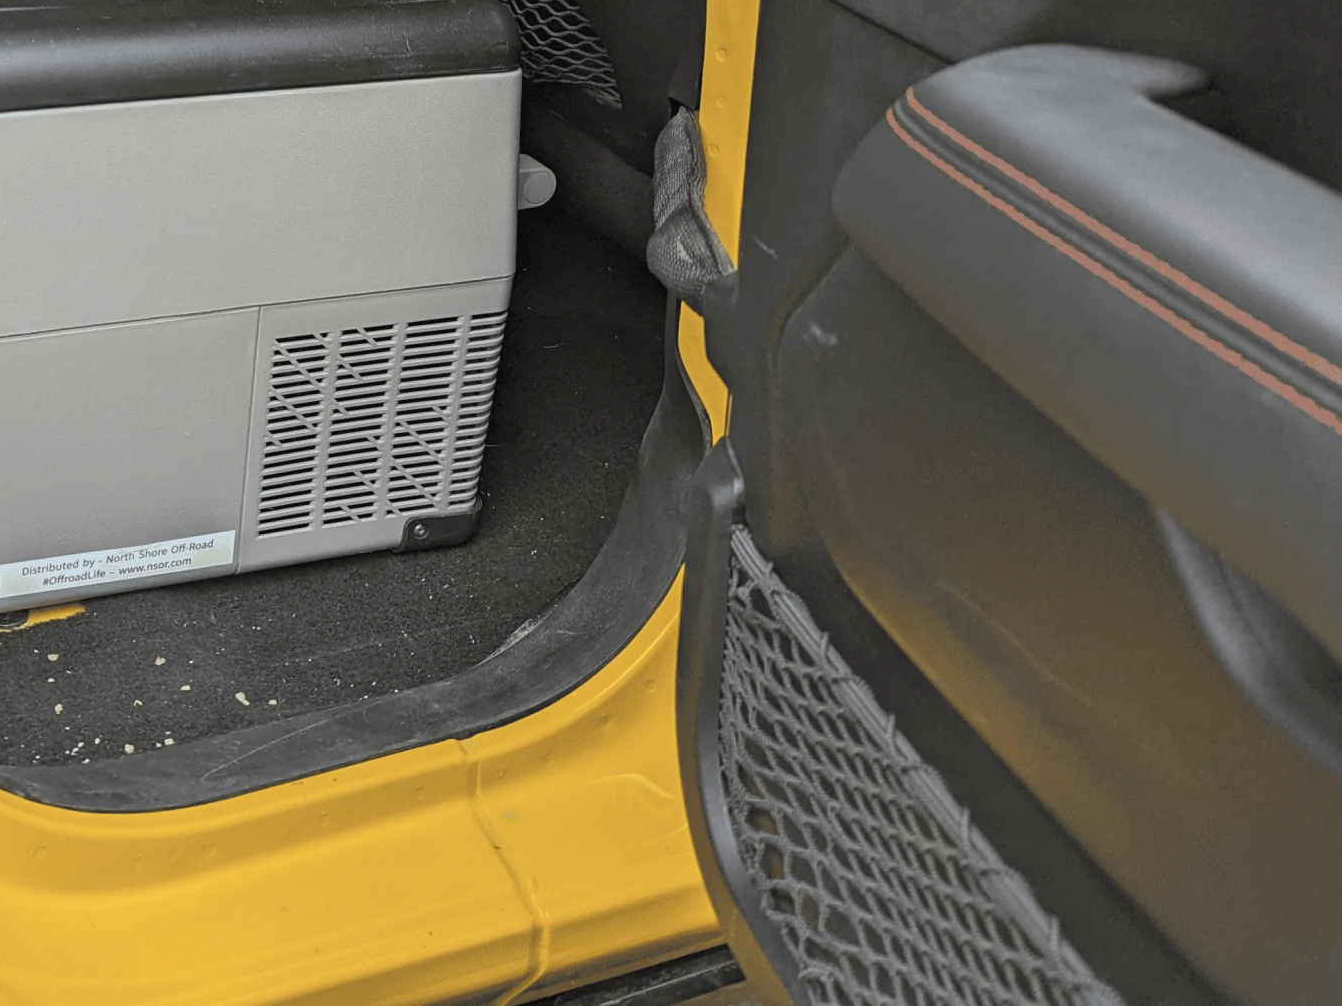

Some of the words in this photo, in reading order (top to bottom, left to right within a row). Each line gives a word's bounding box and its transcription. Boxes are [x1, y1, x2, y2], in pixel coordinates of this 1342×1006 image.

[22, 559, 79, 576] Distributed
[82, 558, 96, 569] by
[106, 552, 135, 564] North
[138, 547, 168, 559] Shore
[171, 539, 214, 555] Off-Road
[43, 569, 106, 586] #OffroadLife
[118, 557, 192, 575] www.nsor.com
